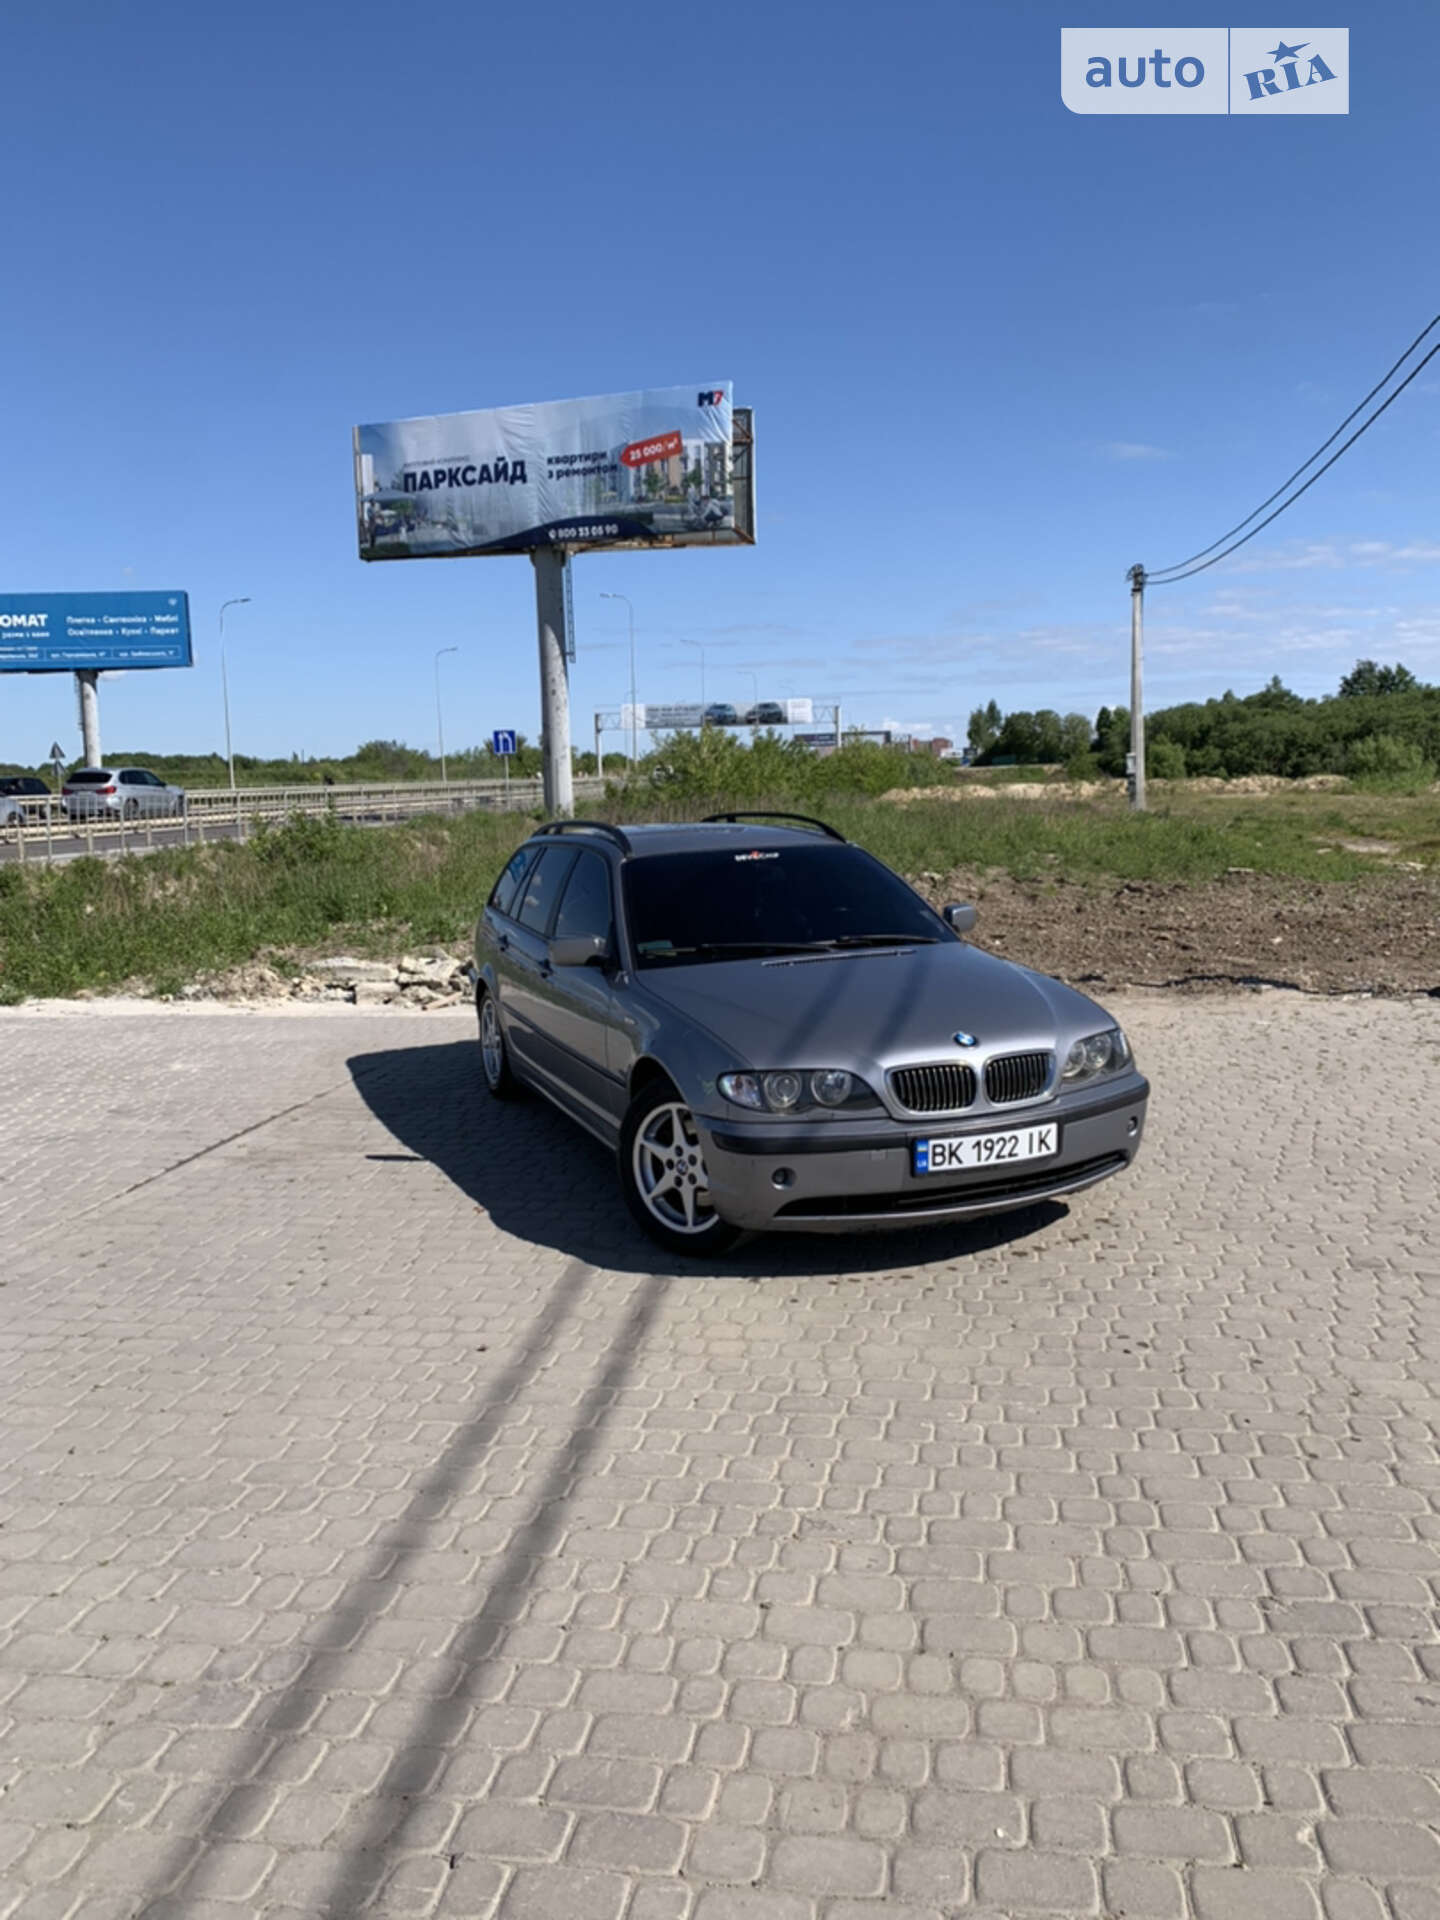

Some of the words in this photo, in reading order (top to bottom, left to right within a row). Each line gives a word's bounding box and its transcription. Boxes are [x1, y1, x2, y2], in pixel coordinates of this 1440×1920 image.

[547, 451, 607, 466] квартири
[403, 456, 527, 493] ПАРКСАЙД
[556, 464, 618, 481] ремонтом
[931, 1141, 963, 1166] BK
[972, 1135, 1019, 1162] 1922
[1028, 1129, 1052, 1154] IK
